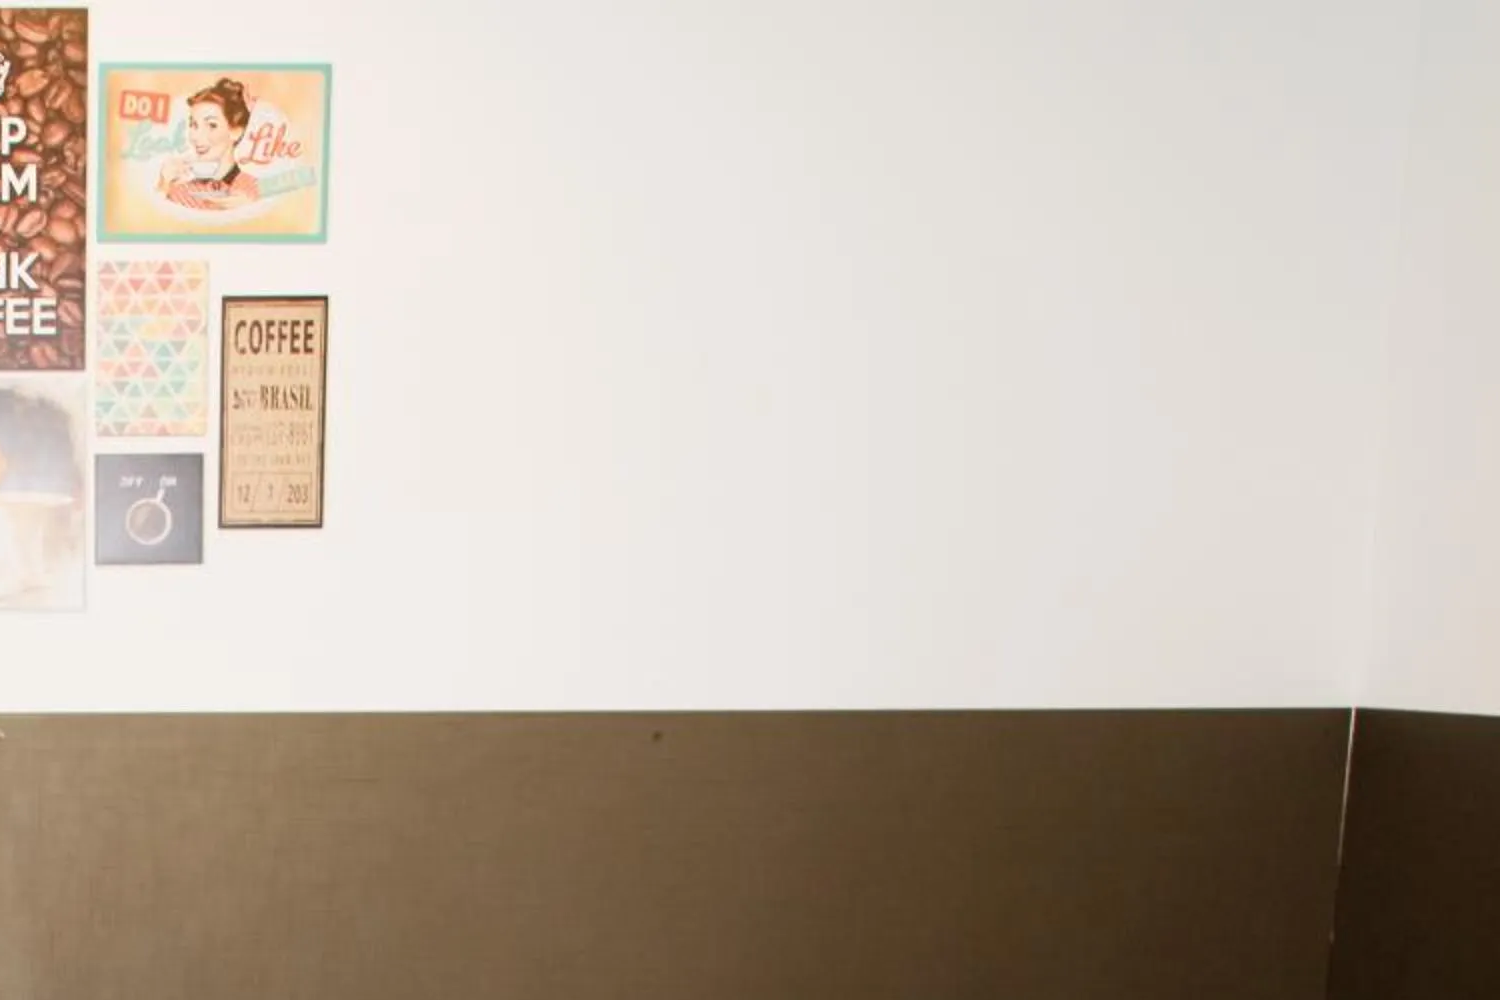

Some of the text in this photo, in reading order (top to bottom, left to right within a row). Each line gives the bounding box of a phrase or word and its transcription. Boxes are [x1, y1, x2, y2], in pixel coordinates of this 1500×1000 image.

[124, 94, 165, 118] DO I
[239, 121, 303, 164] Like
[234, 318, 315, 356] COFFEE
[260, 383, 313, 410] BRASIL
